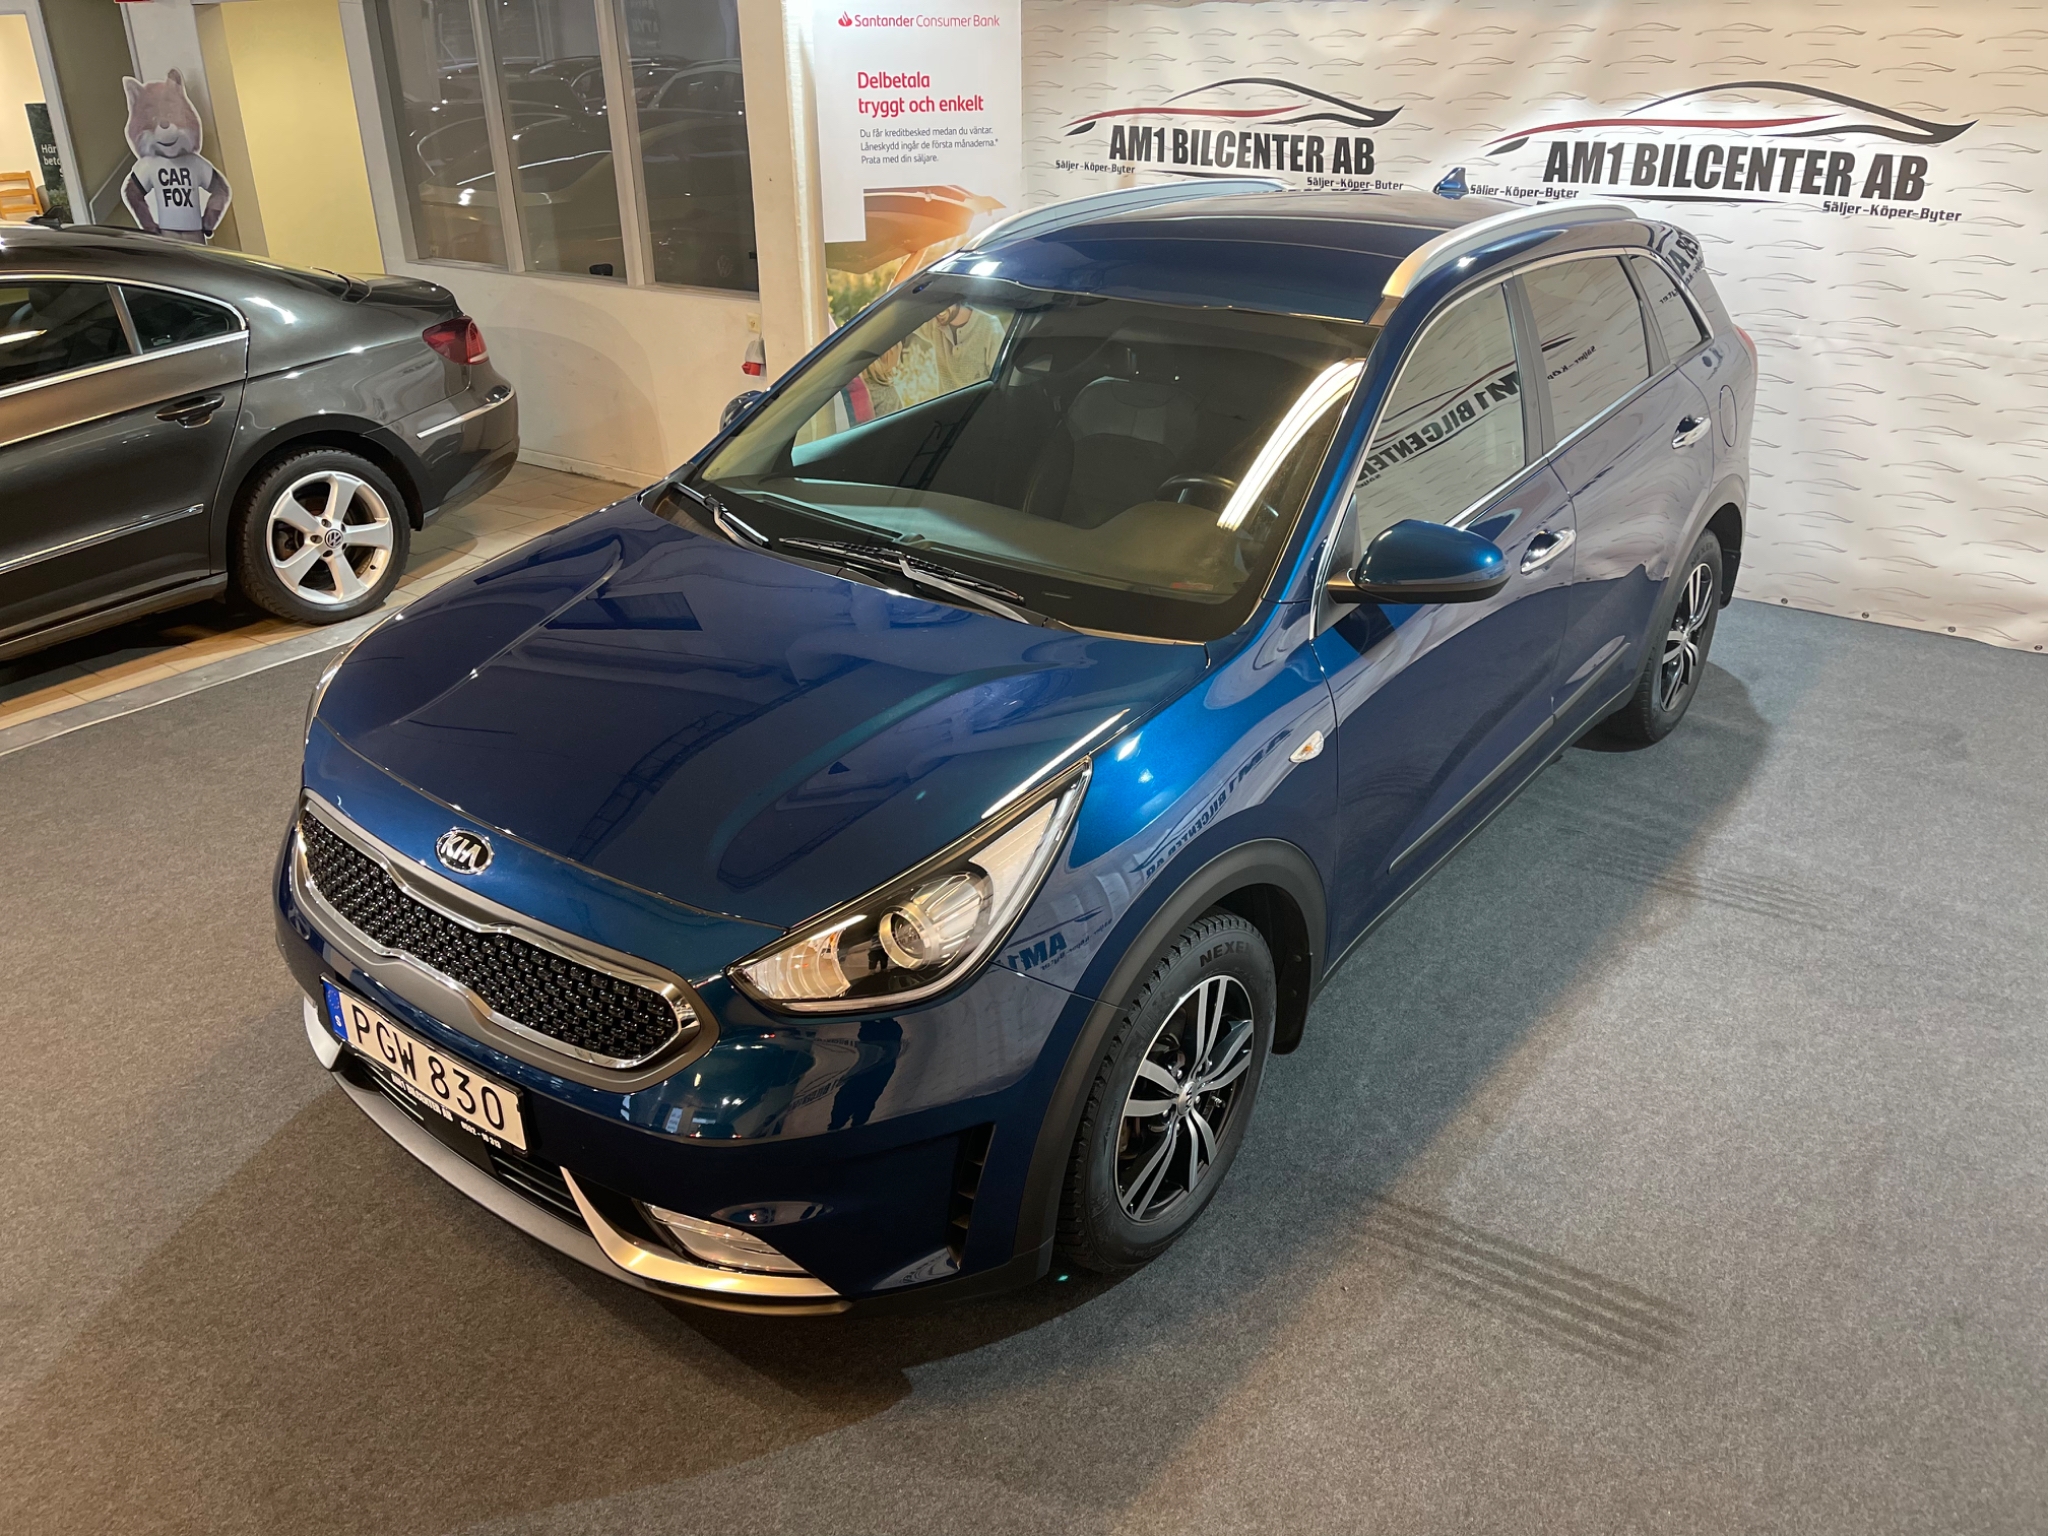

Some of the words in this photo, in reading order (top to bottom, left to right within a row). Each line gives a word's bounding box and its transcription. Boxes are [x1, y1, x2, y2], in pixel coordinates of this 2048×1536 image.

[855, 14, 915, 27] Santander
[916, 14, 971, 27] Consumer
[973, 14, 1000, 27] Bank
[857, 71, 930, 89] Delbetala
[858, 97, 905, 118] tryggt
[909, 95, 935, 113] och
[939, 94, 984, 112] enkelt
[859, 129, 871, 138] Du
[872, 128, 883, 137] får
[885, 128, 931, 137] kreditbesked
[932, 127, 957, 136] medan
[959, 126, 968, 135] du
[969, 126, 993, 135] väntar.
[41, 144, 57, 154] Här
[860, 141, 900, 152] Låneskydd
[901, 140, 919, 152] ingår
[920, 140, 930, 150] de
[932, 139, 953, 149] första
[1109, 124, 1166, 163] AM1
[1172, 128, 1325, 173] BILCENTER
[1331, 136, 1376, 176] AB
[861, 155, 881, 164] Prata
[882, 154, 899, 164] med
[900, 153, 912, 163] din
[913, 153, 939, 164] säljare.
[158, 168, 192, 186] CAR
[1542, 140, 1625, 186] AM1
[1631, 141, 1856, 198] BILCENTER
[1860, 153, 1929, 202] AB
[162, 188, 193, 207] FOX
[440, 832, 482, 868] KIA
[334, 1015, 342, 1028] S
[351, 1004, 418, 1082] PGW
[428, 1055, 504, 1132] 830
